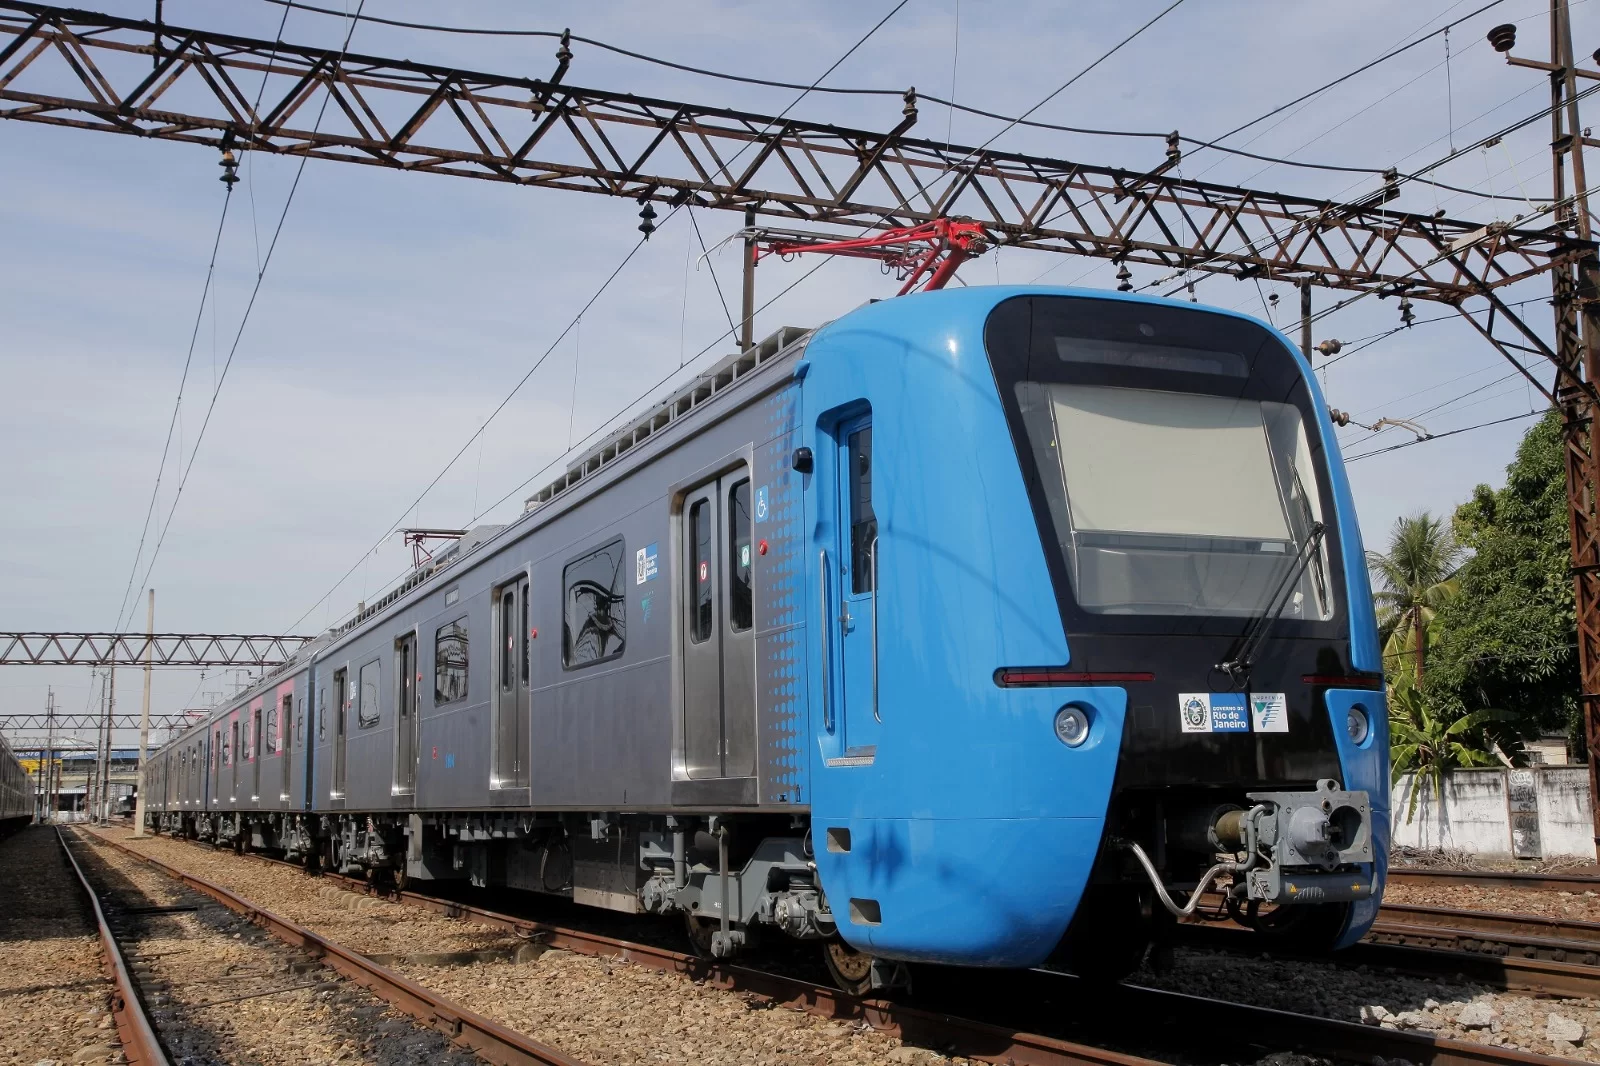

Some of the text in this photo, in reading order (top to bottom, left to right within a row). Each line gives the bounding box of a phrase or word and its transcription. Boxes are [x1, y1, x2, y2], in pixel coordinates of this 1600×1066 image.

[1213, 712, 1239, 720] Rio de
[1213, 720, 1246, 728] Janeiro
